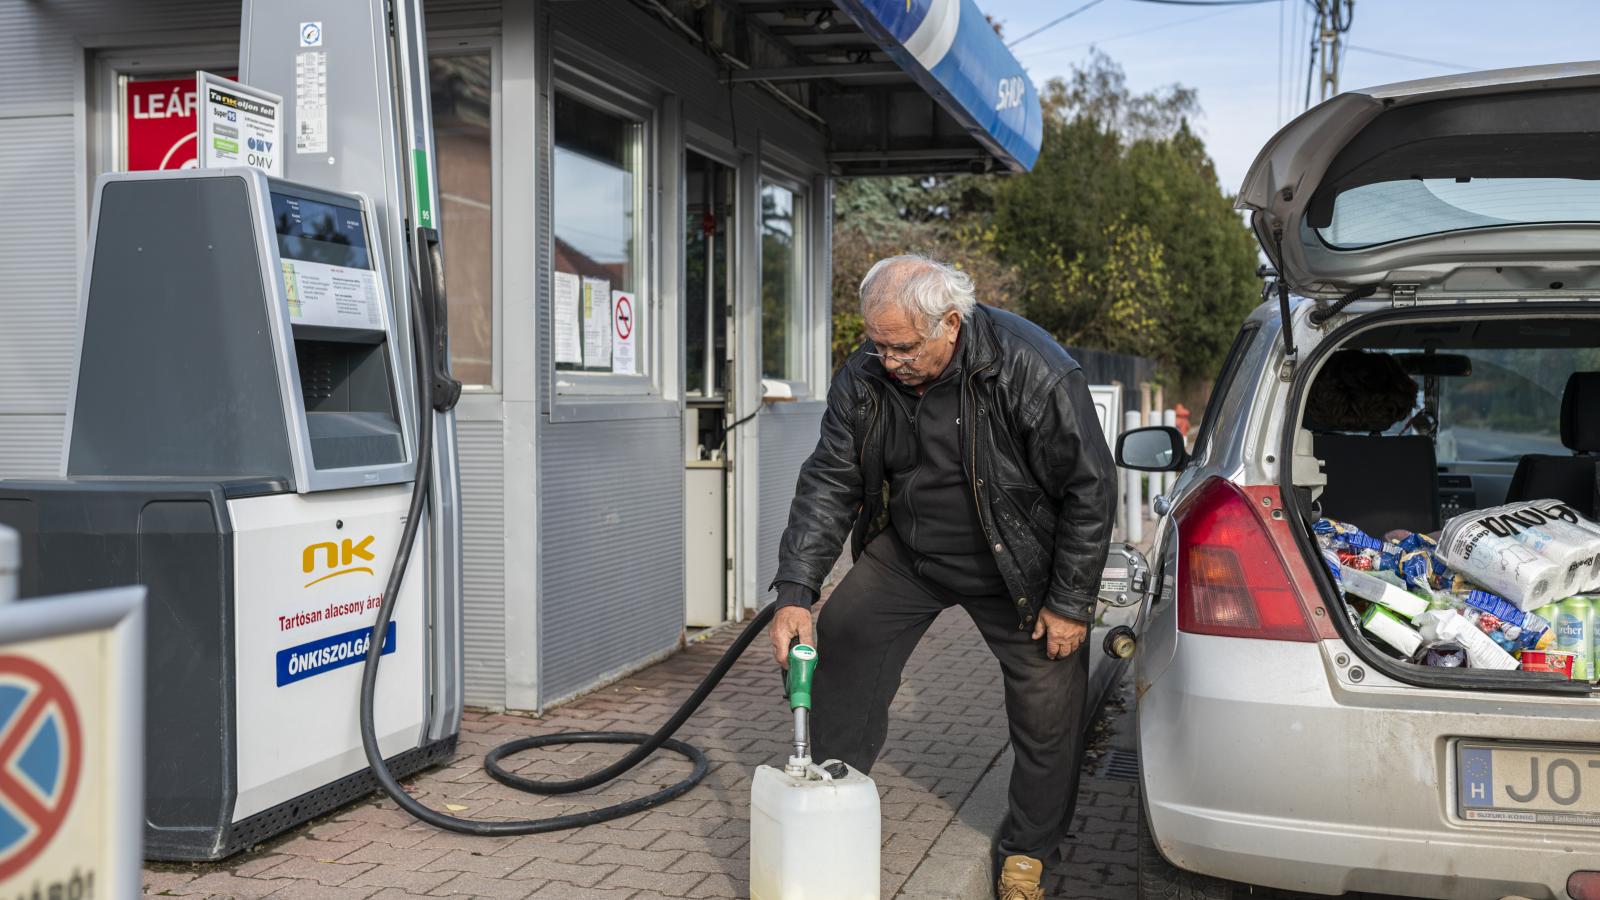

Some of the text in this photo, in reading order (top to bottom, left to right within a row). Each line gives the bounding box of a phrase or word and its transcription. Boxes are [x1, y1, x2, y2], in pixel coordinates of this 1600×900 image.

[133, 86, 197, 119] LEÁR
[247, 154, 273, 169] OMV
[1463, 529, 1490, 560] design
[278, 610, 322, 632] Tartósan
[324, 601, 365, 619] alacsony
[1559, 624, 1583, 636] rcher
[288, 632, 387, 675] ÖNKISZOLGÁ
[1471, 782, 1485, 800] H
